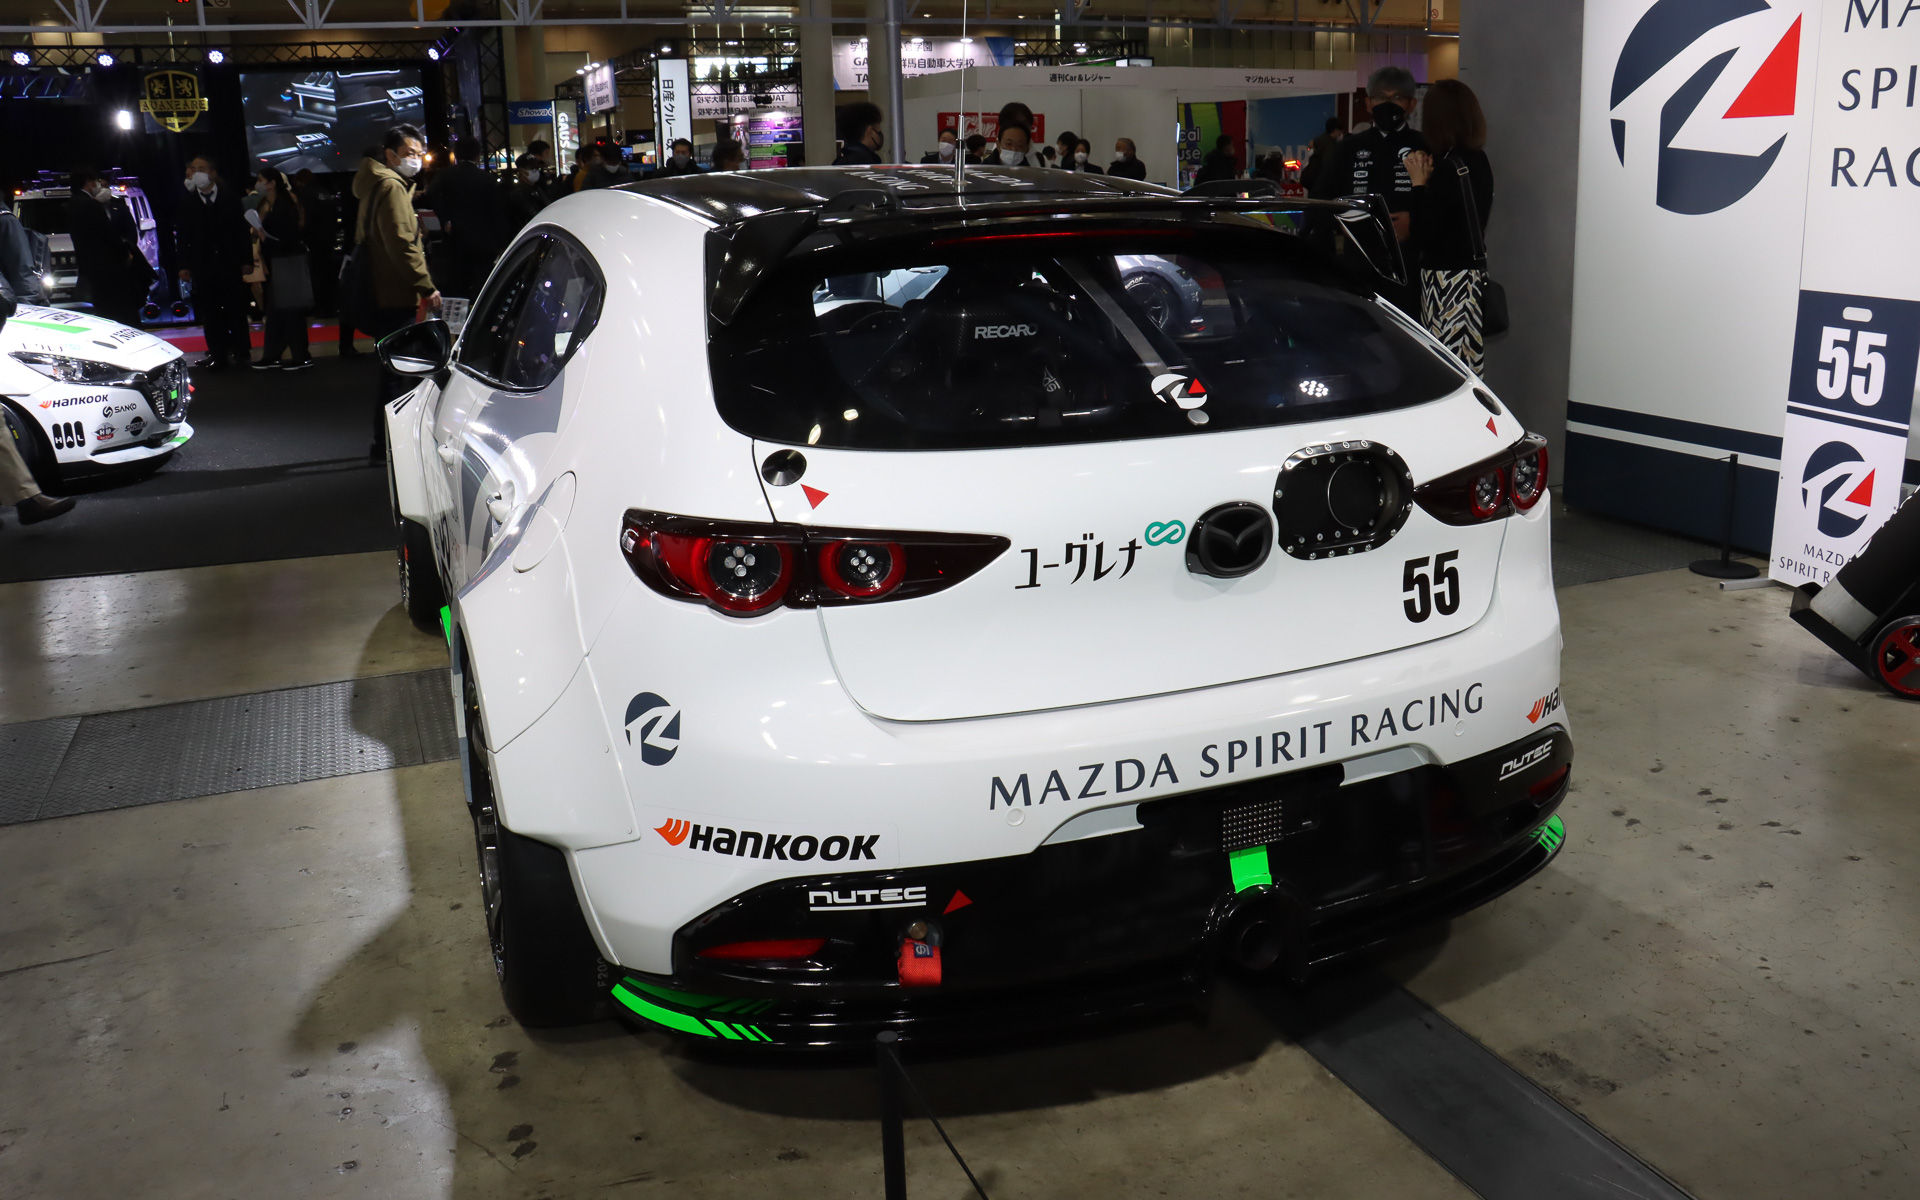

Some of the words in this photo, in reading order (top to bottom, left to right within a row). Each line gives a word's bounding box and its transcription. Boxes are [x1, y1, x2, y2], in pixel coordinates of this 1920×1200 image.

[853, 57, 868, 67] GA
[855, 73, 868, 83] TA
[1245, 76, 1294, 84] マジカルヒューズ
[1838, 65, 1918, 111] SPI
[974, 324, 1037, 339] RECARO
[1816, 325, 1888, 407] 55
[55, 434, 84, 444] HAL
[1014, 532, 1143, 590] ユーグレナ
[1803, 543, 1846, 567] MAZD
[1779, 556, 1818, 579] SPIRIT
[1402, 549, 1460, 624] 55
[990, 752, 1179, 811] MAZDA
[1199, 721, 1332, 779] SPIRIT
[1351, 682, 1483, 746] RACING
[808, 886, 927, 904] NUTEC
